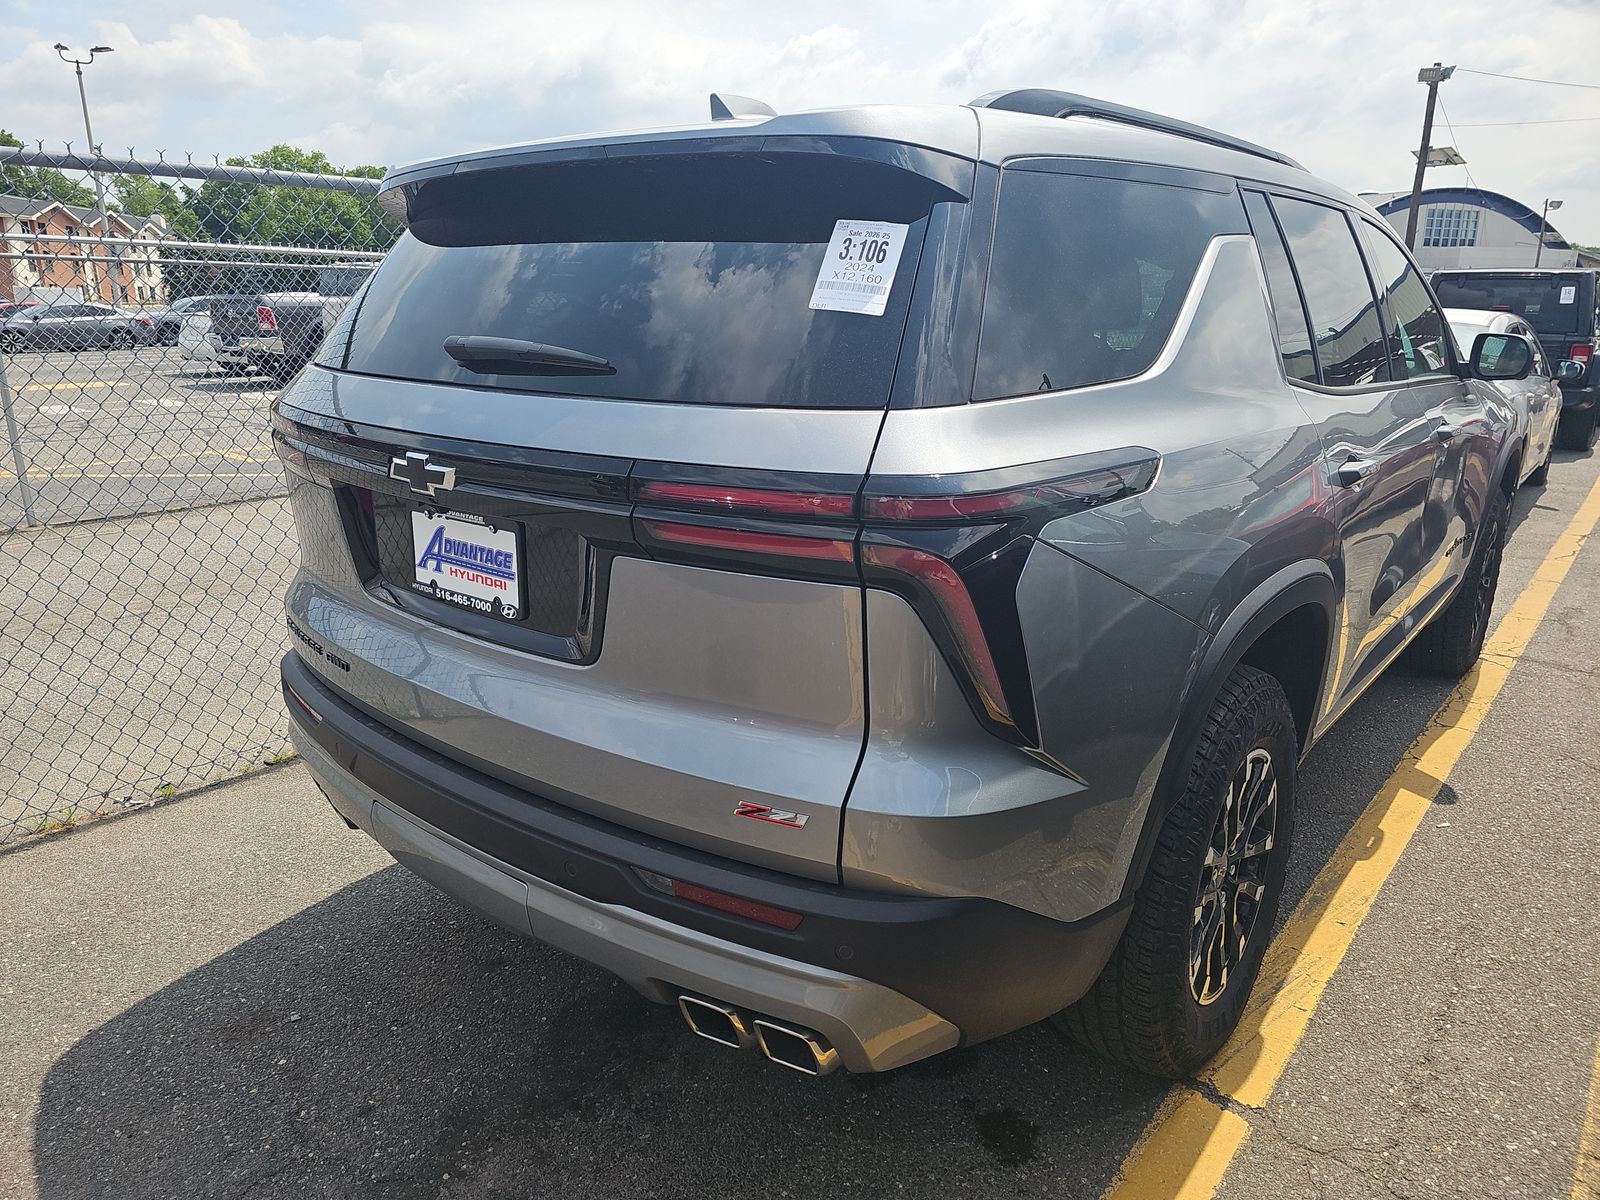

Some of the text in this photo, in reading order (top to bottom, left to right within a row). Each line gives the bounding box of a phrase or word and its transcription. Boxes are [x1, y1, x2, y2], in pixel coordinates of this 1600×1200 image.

[838, 237, 890, 264] 3:106
[844, 261, 875, 273] 2024
[416, 524, 514, 574] ADVANTAGE
[449, 566, 507, 591] HYUNDAI
[436, 588, 492, 612] 516-465-7000
[733, 800, 810, 830] Z71
